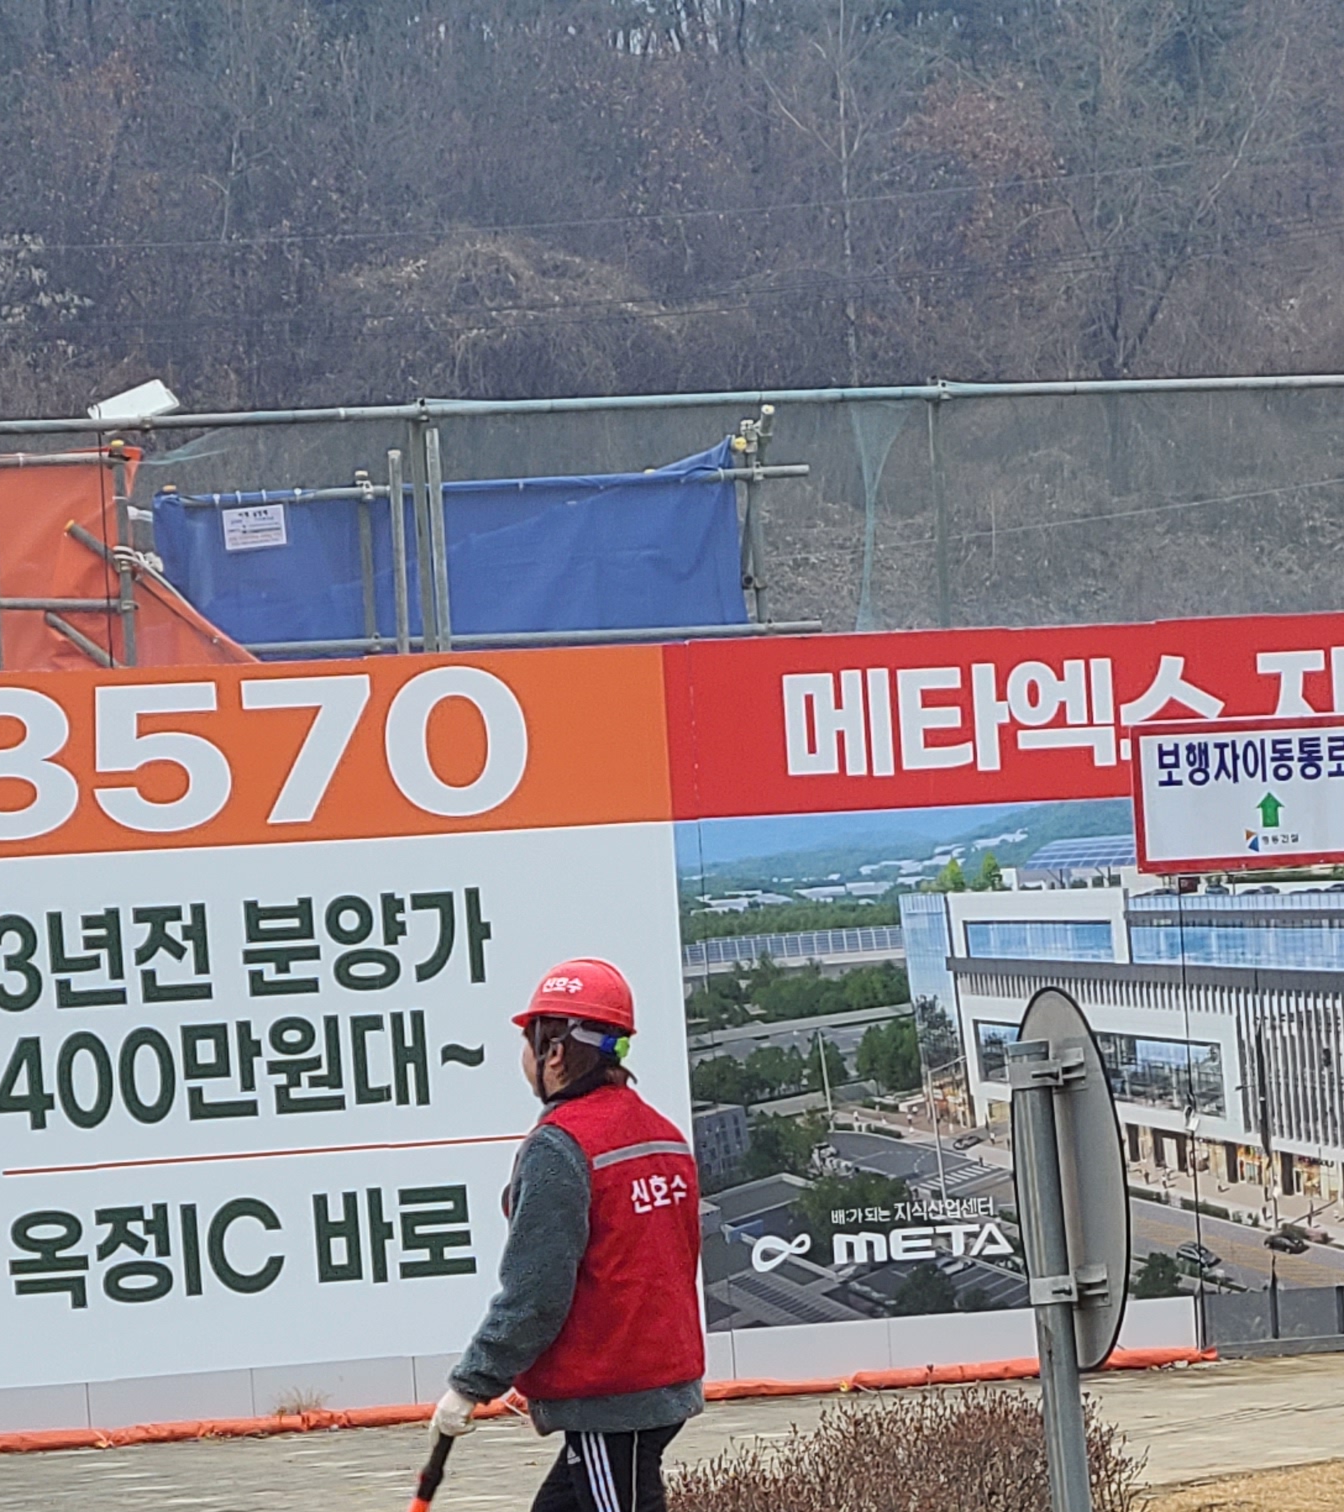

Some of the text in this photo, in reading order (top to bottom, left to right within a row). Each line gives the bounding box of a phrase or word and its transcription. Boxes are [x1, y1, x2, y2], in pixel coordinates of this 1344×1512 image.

[242, 887, 492, 997] 분양가
[630, 1173, 688, 1215] 신호수
[894, 1196, 994, 1221] 지식산업센터
[9, 1184, 477, 1309] 옥정IC 바로
